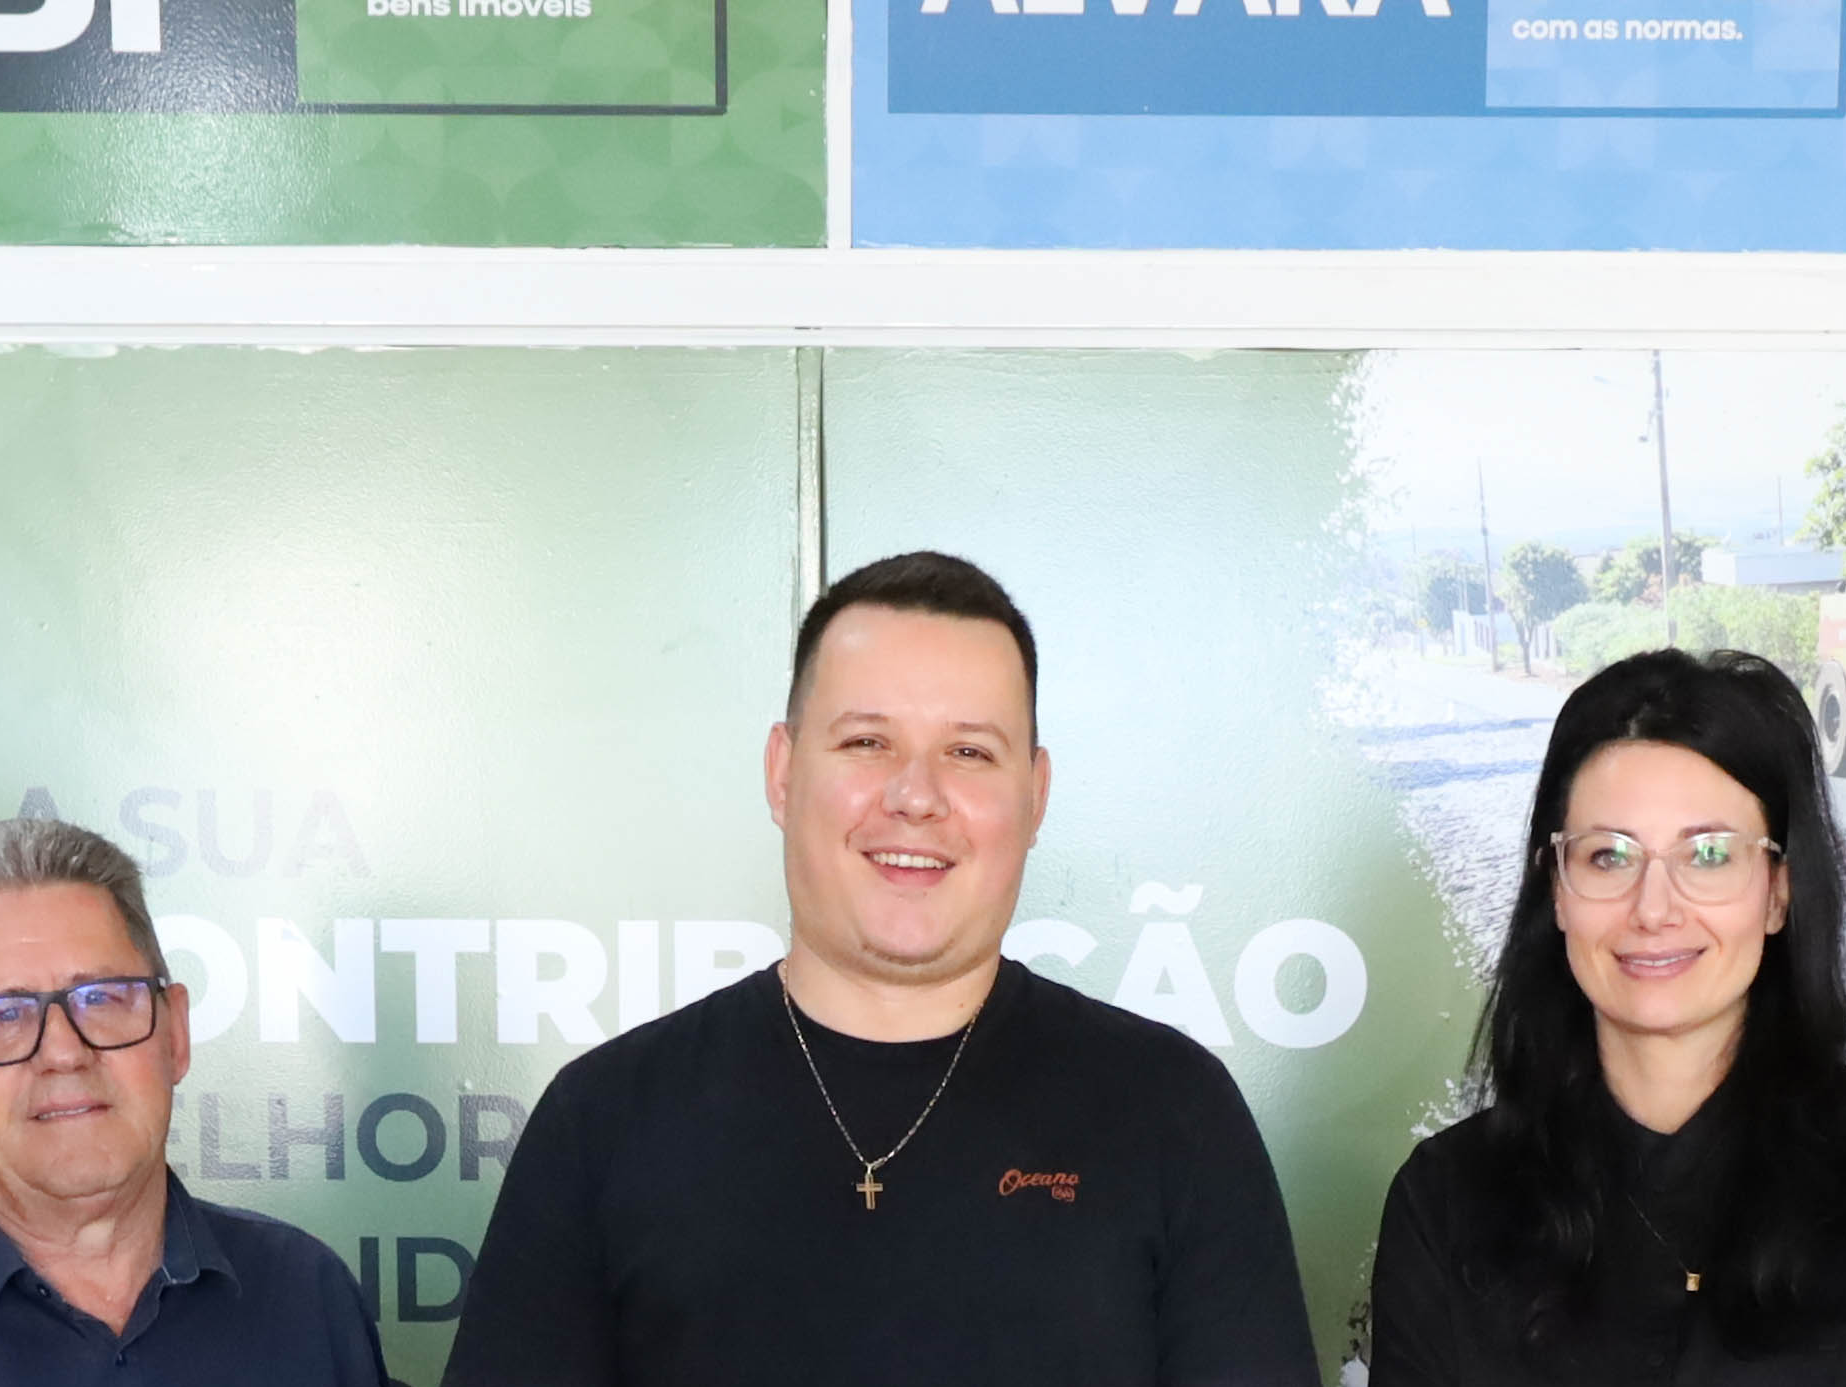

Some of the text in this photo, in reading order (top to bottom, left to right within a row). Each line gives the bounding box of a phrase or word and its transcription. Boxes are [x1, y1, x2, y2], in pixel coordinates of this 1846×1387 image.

[1512, 19, 1743, 40] com as normas.
[118, 786, 372, 879] SUA
